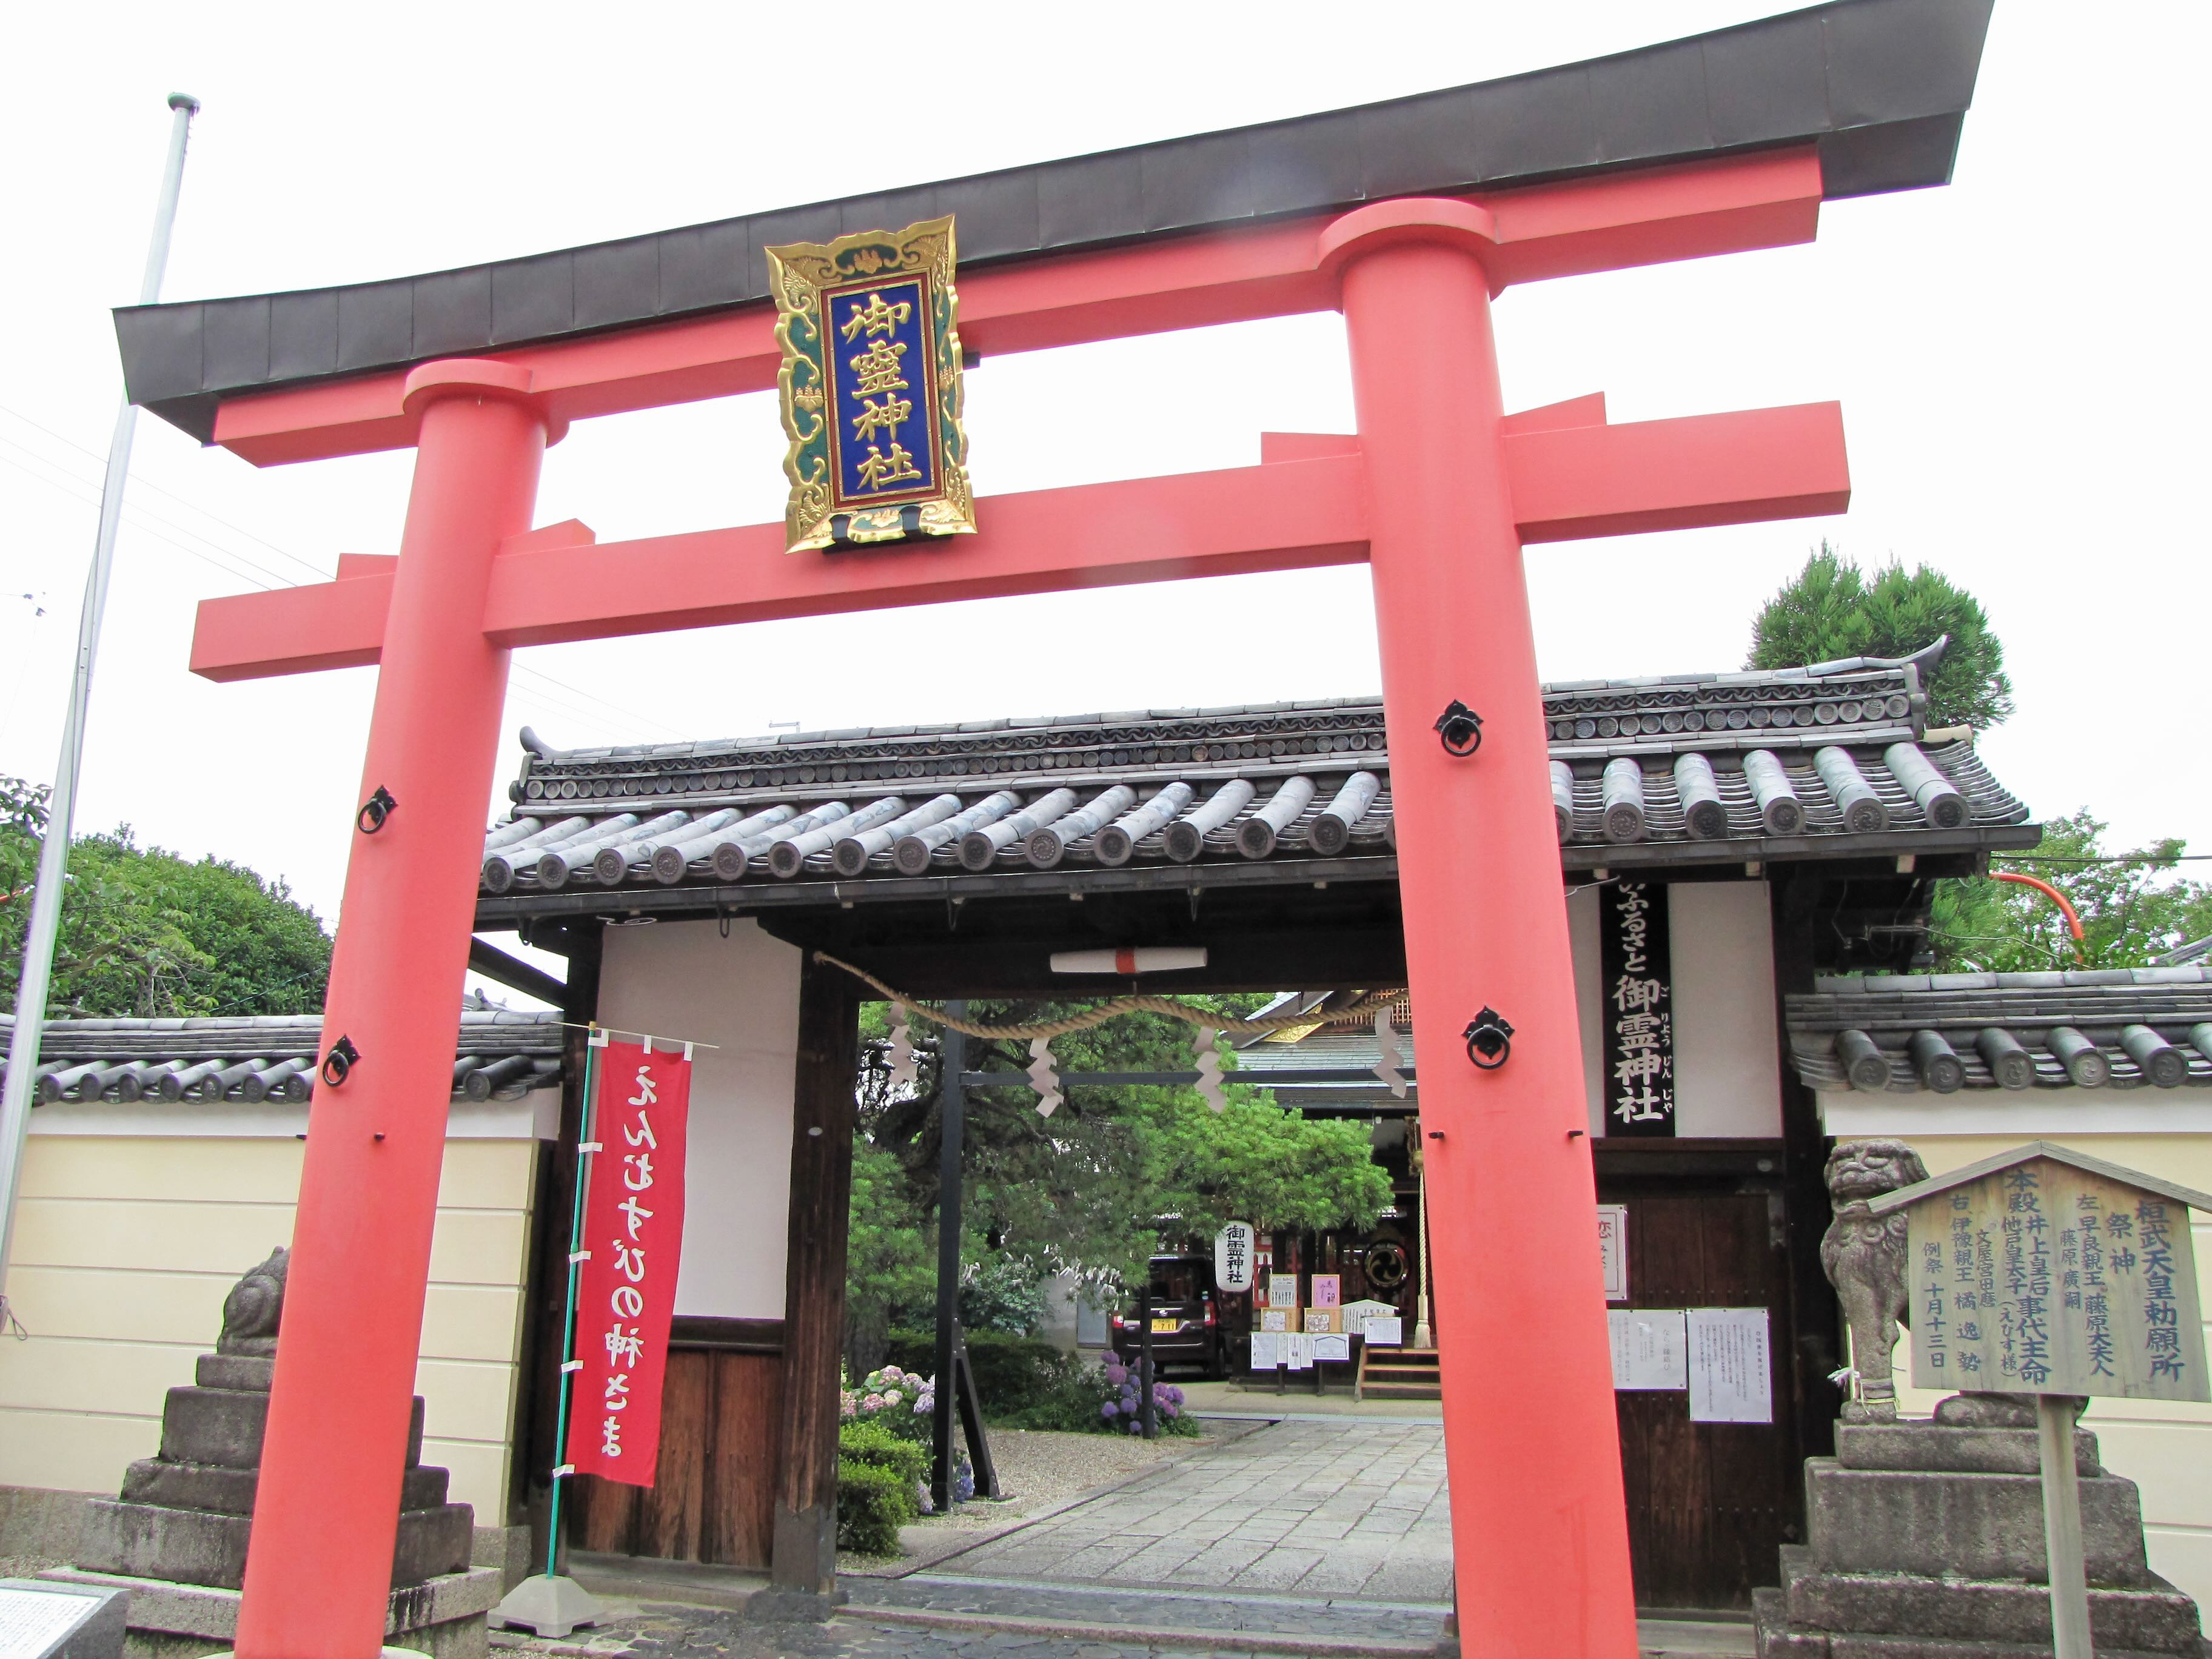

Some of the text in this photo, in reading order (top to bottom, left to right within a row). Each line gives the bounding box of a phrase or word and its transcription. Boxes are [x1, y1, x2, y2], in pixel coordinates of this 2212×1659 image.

[1225, 1224, 1245, 1284] 御霊神社
[2004, 1168, 2041, 1213] 本殿
[2105, 1212, 2136, 1275] 祭神
[1922, 1241, 1947, 1368] 例祭 十月十三日
[2014, 1213, 2053, 1386] 井上皇后 事代主命
[2076, 1193, 2115, 1377] 左 早良親王 藤原大夫人
[2134, 1199, 2185, 1382] 桓武天皇勅願所
